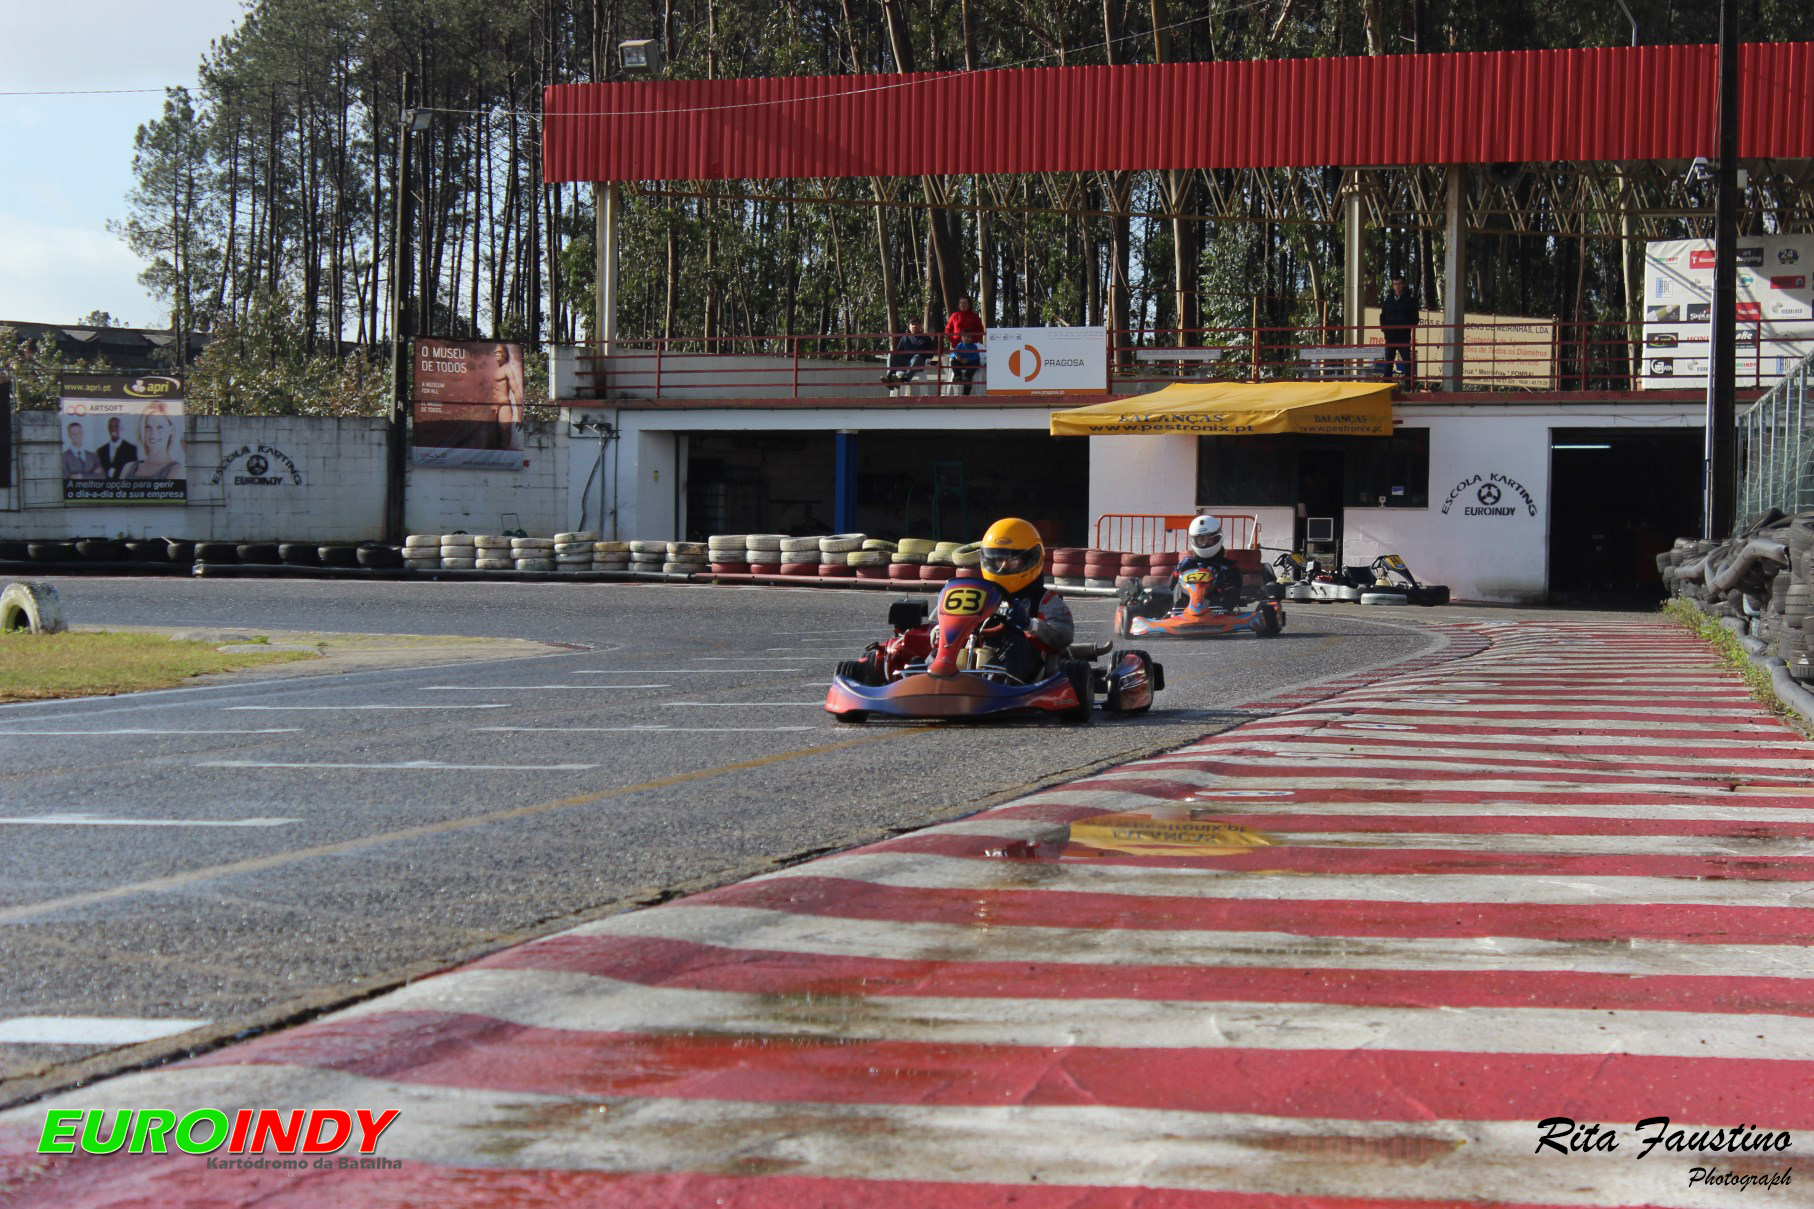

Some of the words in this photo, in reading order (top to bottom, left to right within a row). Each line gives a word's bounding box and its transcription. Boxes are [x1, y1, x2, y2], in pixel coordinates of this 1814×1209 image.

[421, 346, 429, 357] O
[432, 347, 466, 360] MUSEU
[421, 360, 434, 372] DE
[435, 361, 467, 374] TODOS
[1044, 359, 1085, 367] PRAGOSA
[63, 384, 112, 392] www.apri.pt
[146, 381, 169, 394] apri
[1119, 414, 1224, 424] BALANÇAS
[1088, 424, 1254, 434] www.pestronix.pt
[211, 446, 251, 485] ESCOLA
[257, 445, 303, 486] KARTING
[75, 480, 105, 488] melhor
[105, 481, 131, 491] opção
[132, 481, 151, 490] para
[153, 481, 175, 490] gerir
[233, 476, 283, 486] EUROINDY
[75, 490, 114, 498] dia-a-dia
[115, 490, 127, 498] da
[146, 491, 184, 500] empresa
[1441, 474, 1482, 515] ESCOLA
[1490, 473, 1538, 517] KARTING
[1464, 507, 1516, 516] EUROINDY
[1187, 572, 1208, 583] 67
[945, 589, 982, 611] 63
